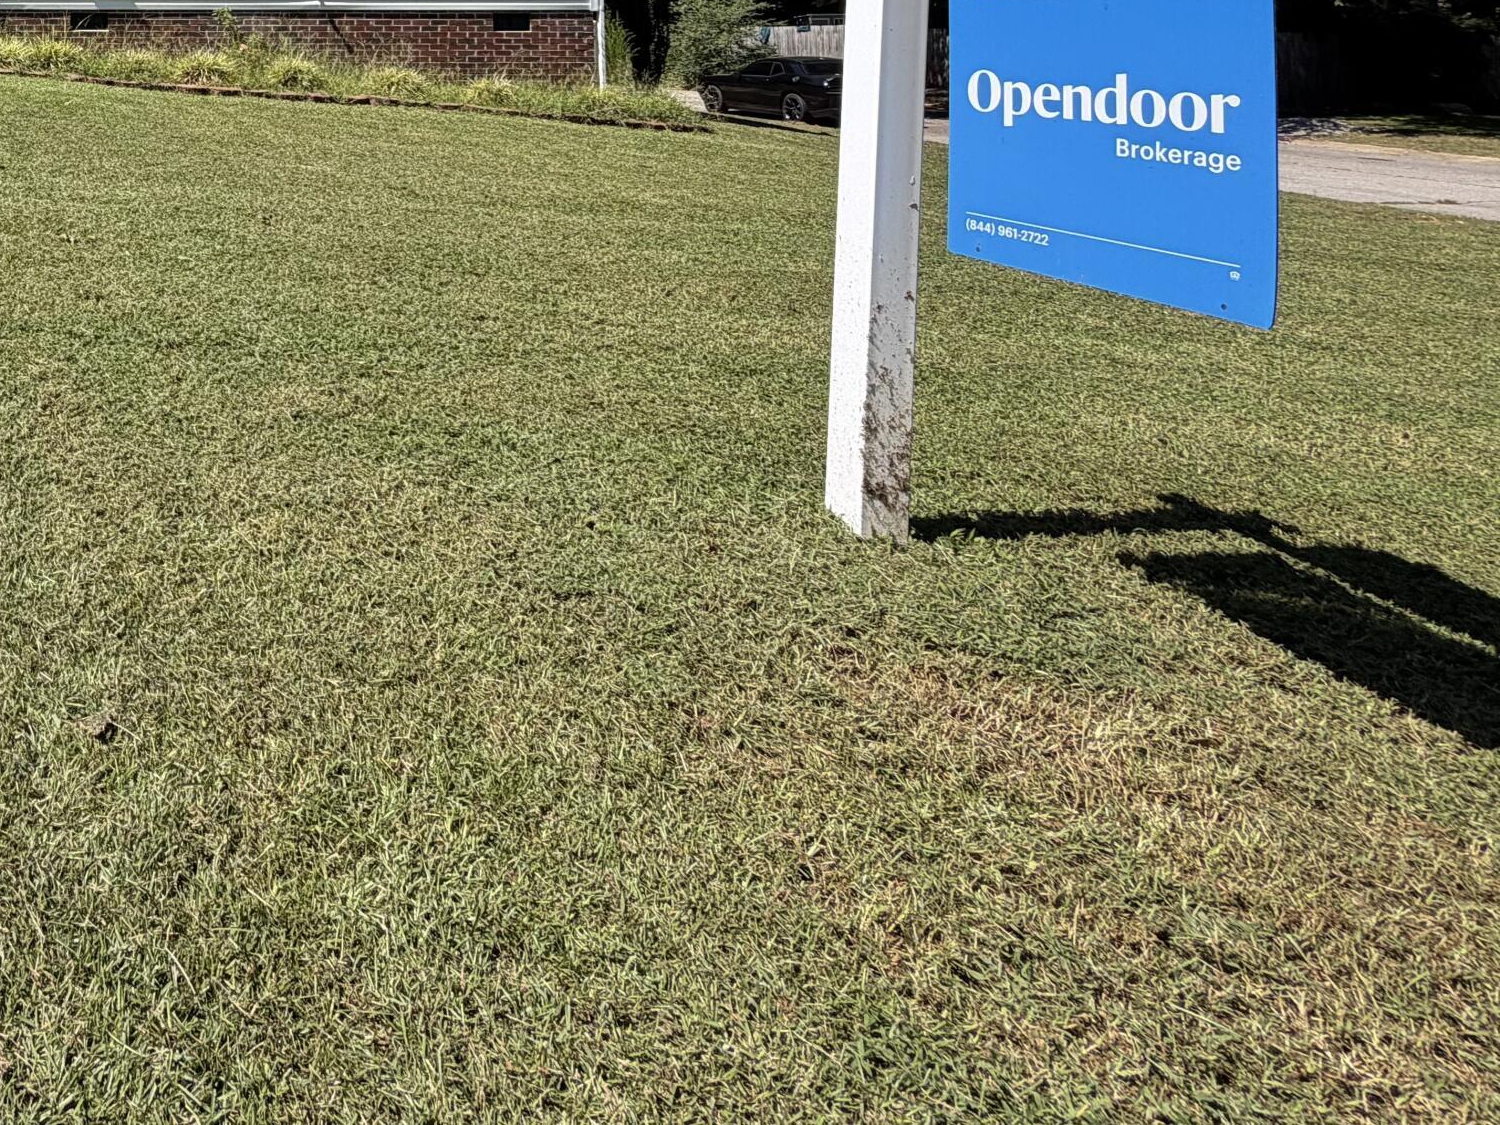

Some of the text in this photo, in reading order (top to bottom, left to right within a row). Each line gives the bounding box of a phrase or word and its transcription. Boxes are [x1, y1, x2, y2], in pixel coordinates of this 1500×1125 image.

[967, 69, 1241, 134] Opendoor
[1115, 138, 1242, 173] Brokerage
[965, 217, 1050, 246] (844) 961-2722
